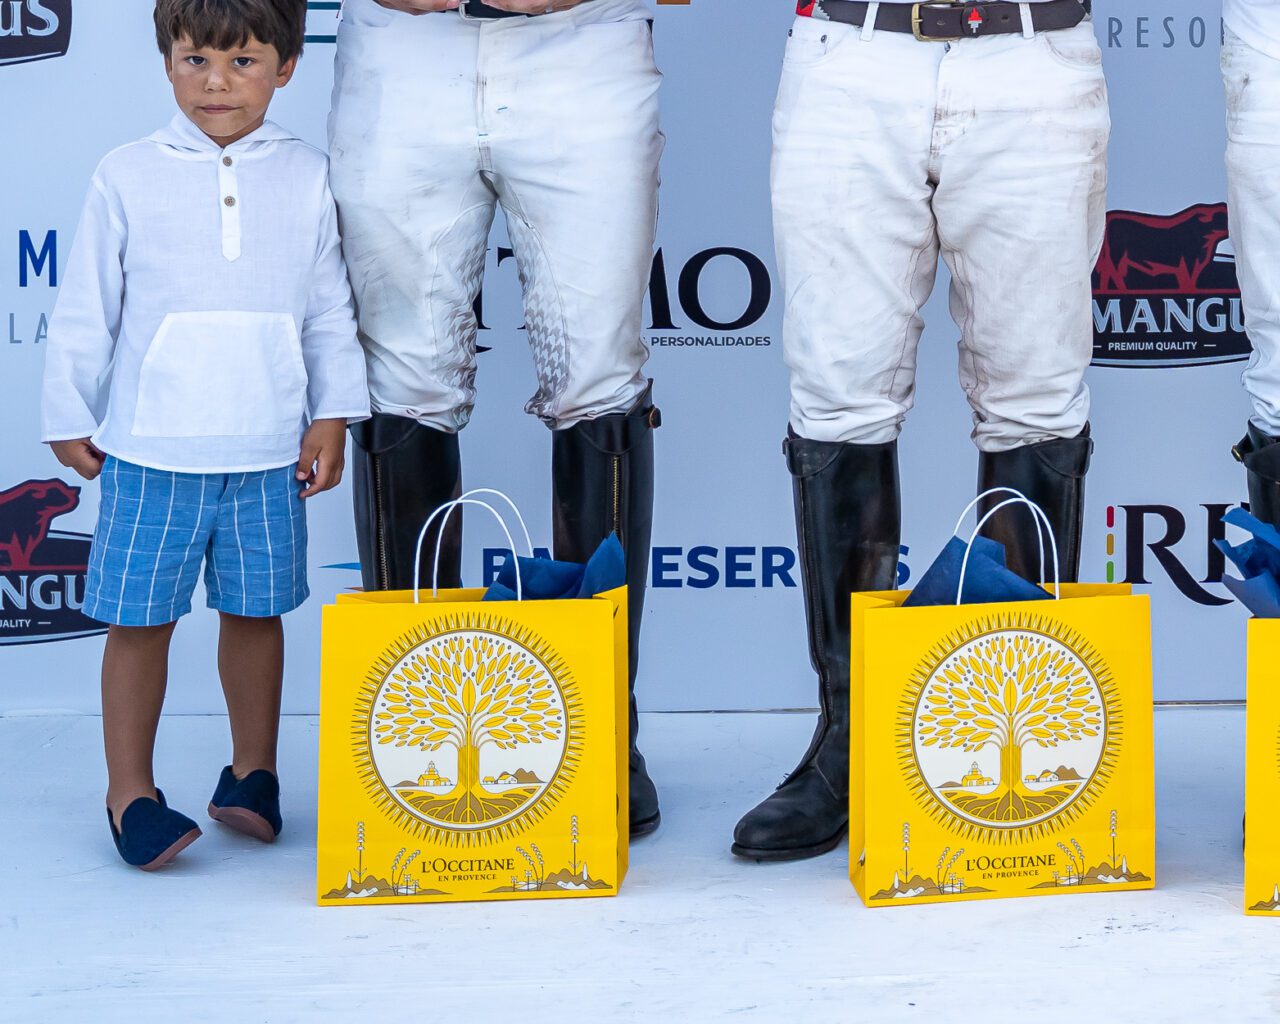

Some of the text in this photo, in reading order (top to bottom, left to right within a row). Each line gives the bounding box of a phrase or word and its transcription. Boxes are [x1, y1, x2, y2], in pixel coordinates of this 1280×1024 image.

[1107, 16, 1224, 48] RESO
[650, 336, 771, 347] PERSONALIDADES
[1108, 341, 1198, 352] PREMIUM QUALITY
[421, 857, 515, 874] L'OCCITANE
[965, 854, 1057, 872] L'OCCITANE
[452, 873, 497, 882] PROVENCE
[982, 869, 1039, 880] EN PROVENCE
